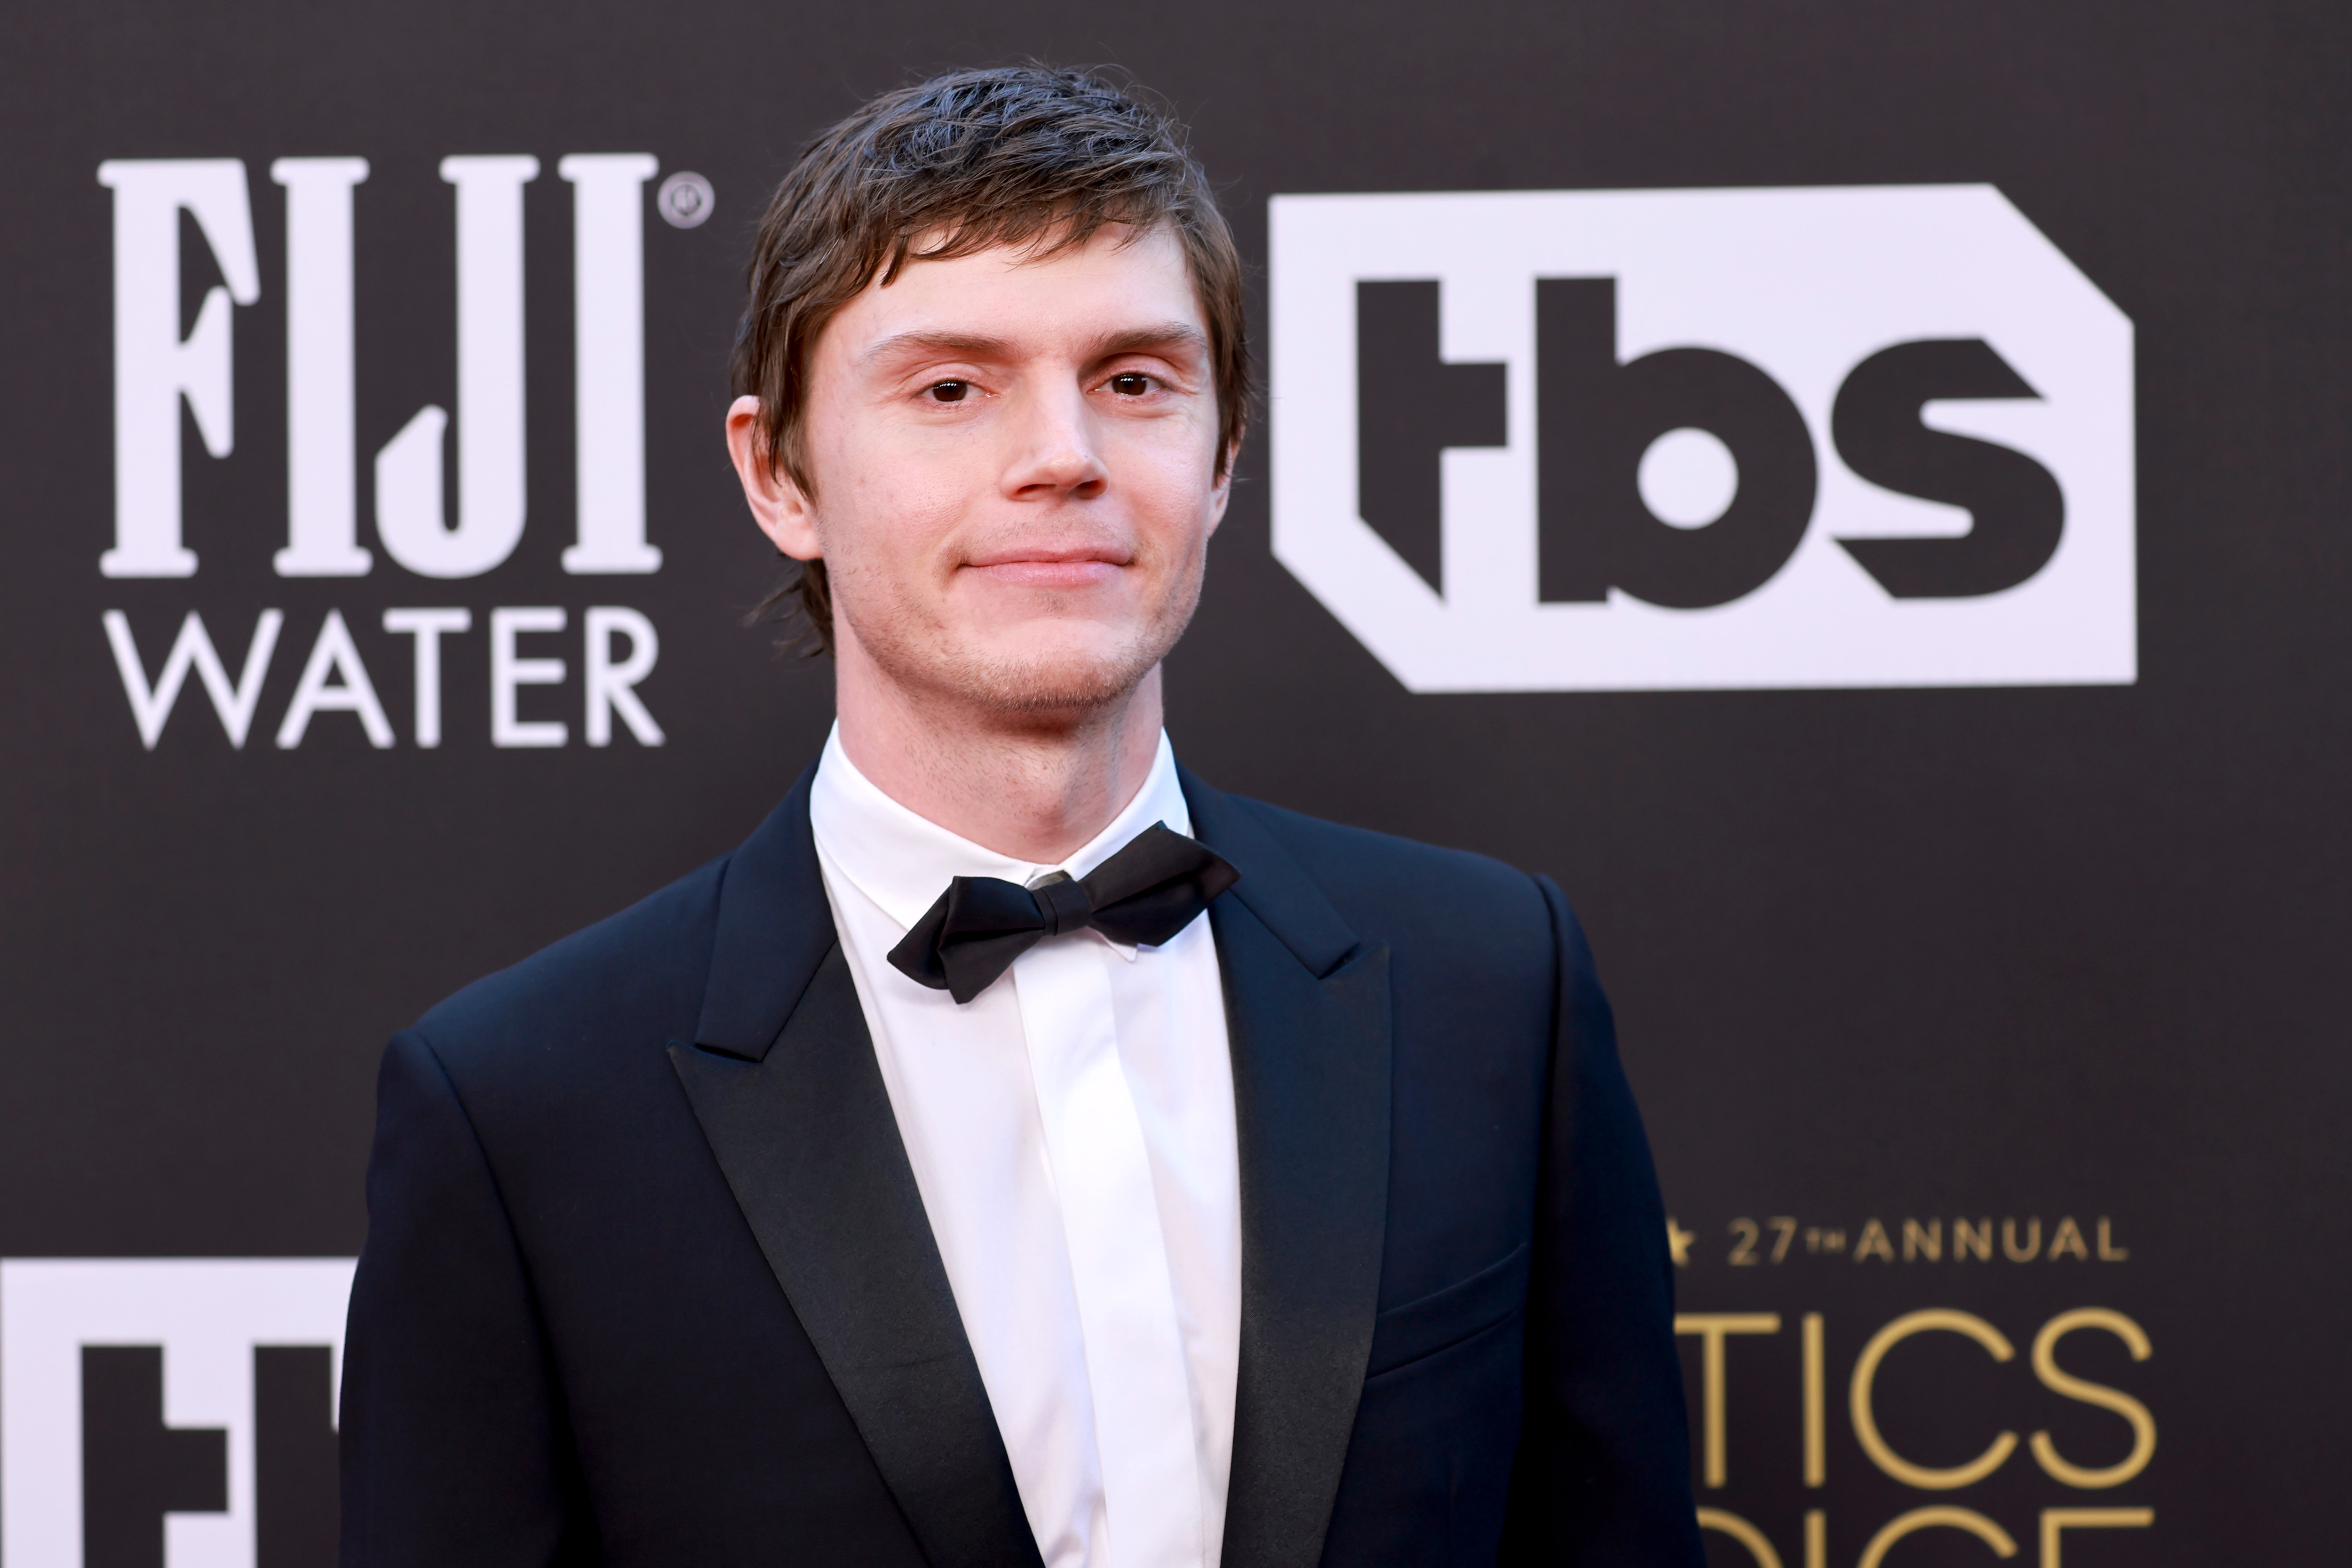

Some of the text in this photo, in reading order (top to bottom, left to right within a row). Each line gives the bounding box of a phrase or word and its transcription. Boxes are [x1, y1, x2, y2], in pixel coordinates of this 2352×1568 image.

[96, 152, 664, 579] FIJI
[1356, 277, 2066, 611] tbs
[101, 605, 666, 750] WATER
[1852, 1216, 2131, 1263] ANNUAL
